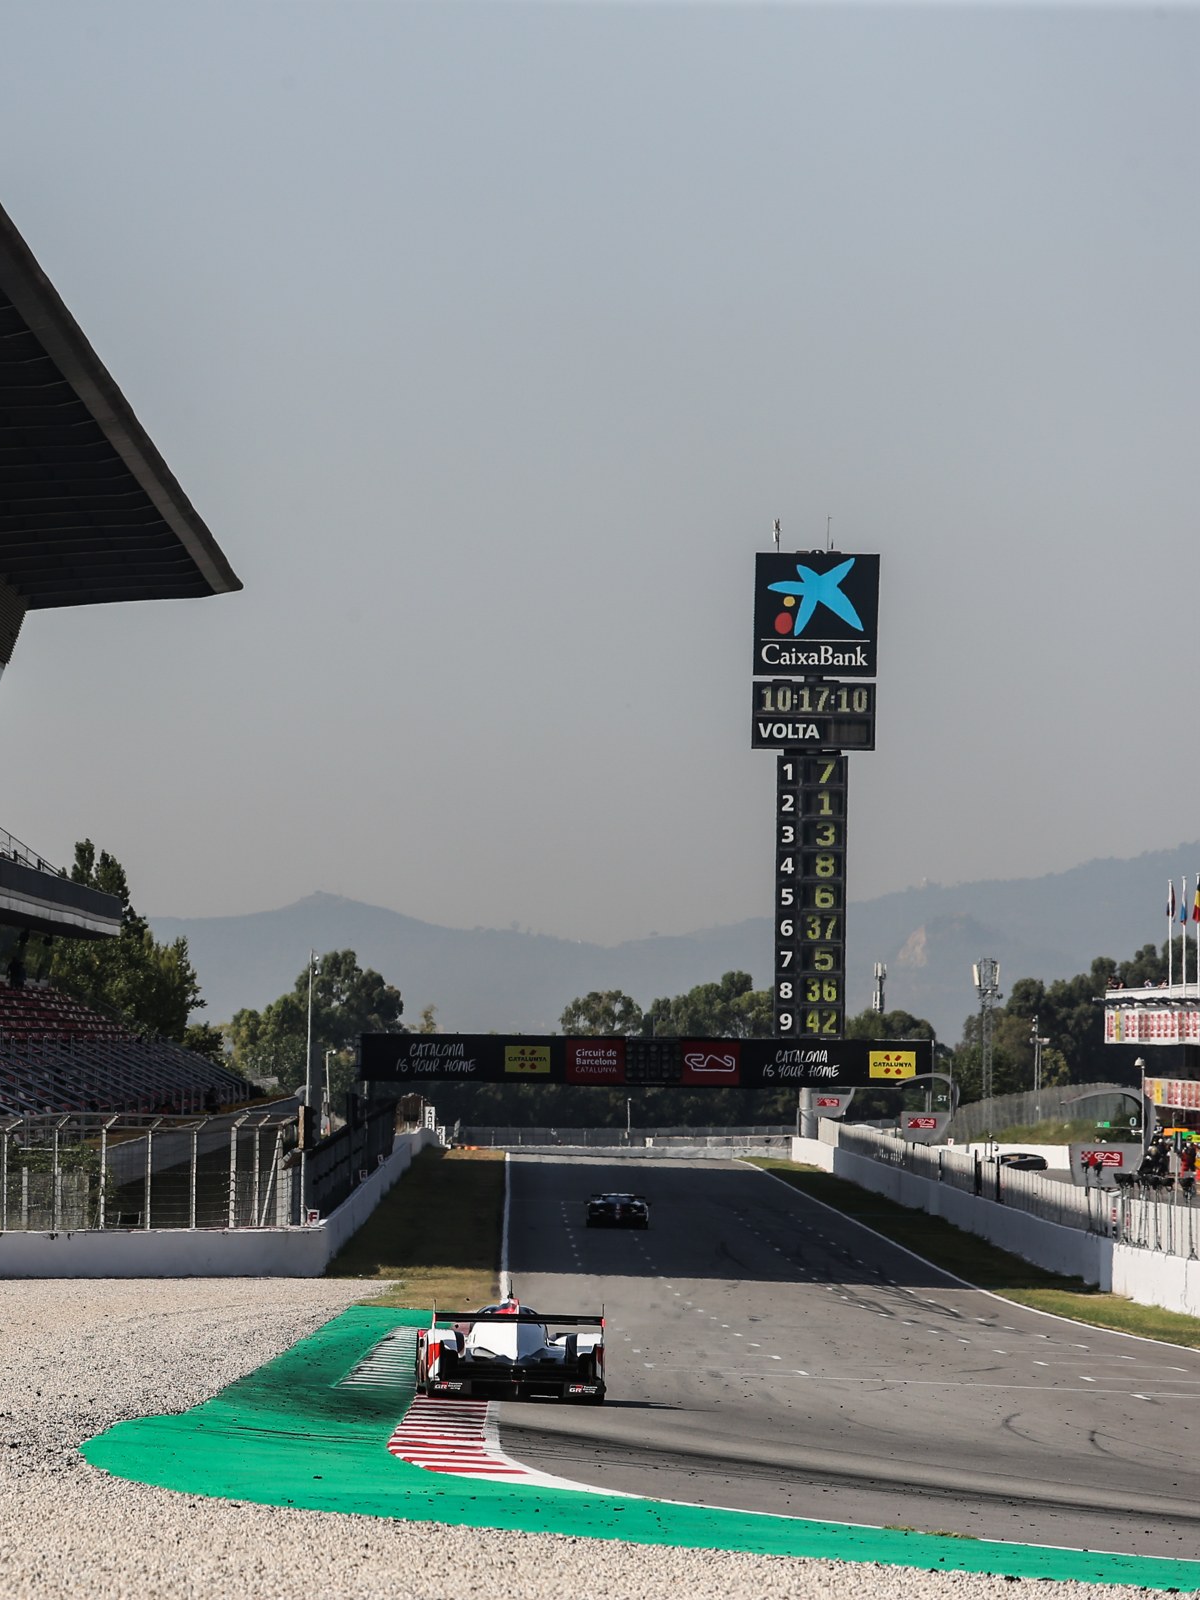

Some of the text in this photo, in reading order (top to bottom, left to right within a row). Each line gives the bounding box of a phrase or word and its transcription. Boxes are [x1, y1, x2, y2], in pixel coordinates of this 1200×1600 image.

[761, 644, 869, 666] CaixaBank
[761, 686, 868, 713] 10:17:10
[758, 723, 820, 739] VOLTA
[783, 759, 836, 784] 1 7
[782, 790, 833, 815] 2 1
[782, 822, 835, 847] 3 3
[780, 853, 835, 878] 4 8
[781, 884, 834, 909] 5 6
[780, 915, 837, 940] 6 37
[780, 947, 833, 971] 7 5
[779, 977, 837, 1002] 8 36
[779, 1009, 837, 1034] 9 42
[409, 1043, 464, 1057] CATALONIA
[575, 1048, 617, 1057] Circuit de
[575, 1057, 617, 1065] Barcelona
[775, 1049, 828, 1063] CATALONIA
[396, 1058, 477, 1073] IS YOUR HOME
[762, 1064, 840, 1078] IS YOUR HOME
[309, 1211, 318, 1222] F
